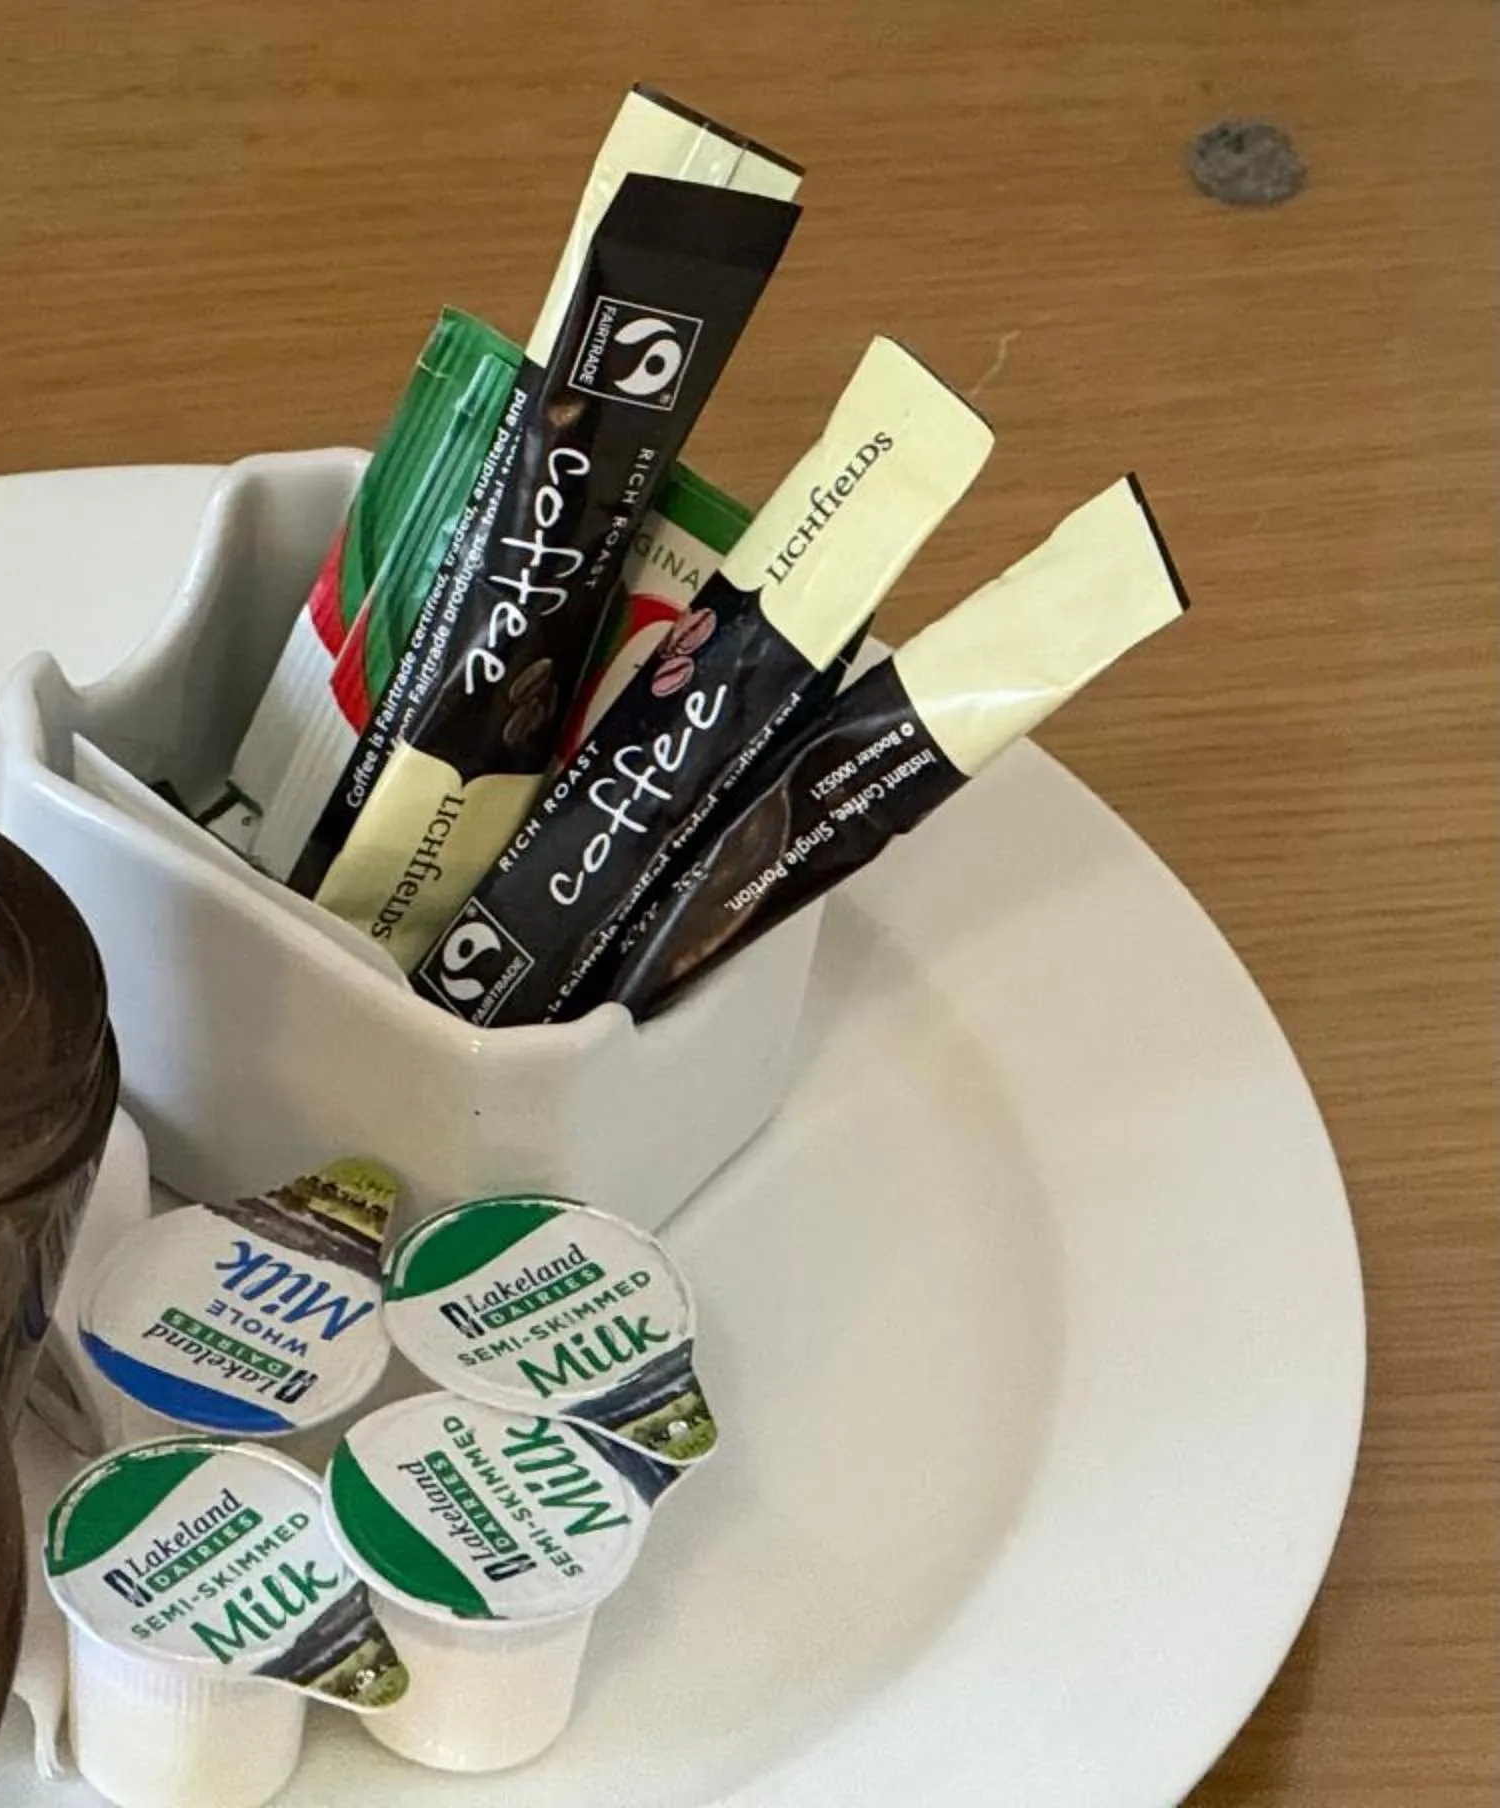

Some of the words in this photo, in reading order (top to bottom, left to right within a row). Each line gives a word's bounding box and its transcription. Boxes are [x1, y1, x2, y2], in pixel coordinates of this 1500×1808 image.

[579, 303, 617, 385] FAIRTRADE
[505, 387, 528, 425] and
[474, 427, 509, 499] audited
[623, 447, 655, 505] RICH
[465, 447, 590, 694] coffee
[585, 515, 628, 590] ROAST
[375, 651, 418, 732] Fairtrade
[407, 623, 450, 706] Fairtrade
[373, 733, 387, 750] is
[857, 730, 901, 766] Booker
[880, 748, 938, 789] Instant
[346, 753, 377, 808] Coffee
[500, 818, 541, 873] RICH
[544, 740, 600, 813] ROAST
[549, 684, 728, 905] coffee
[810, 763, 858, 800] 000521
[829, 782, 885, 822] Coffee,
[788, 820, 835, 864] Single
[724, 863, 788, 911] Portion.
[215, 1241, 375, 1341] Milk
[467, 1243, 590, 1315] Lakeland
[489, 1269, 597, 1324] DAIRIES
[167, 1310, 285, 1375] DAIRIES
[205, 1299, 309, 1357] WHOLE
[457, 1270, 652, 1367] SEMI-SKIMMED
[141, 1323, 281, 1395] Lakeland
[516, 1314, 671, 1398] Milk
[398, 1461, 496, 1562] Lakeland
[429, 1459, 511, 1548] DAIRIES
[443, 1415, 584, 1579] SEMI-SKIMMED
[502, 1416, 631, 1537] Milk
[128, 1488, 242, 1577] Lakeland
[154, 1515, 255, 1586] DAIRIES
[131, 1512, 310, 1640] SEMI-SKIMMED
[190, 1561, 339, 1665] Milk
